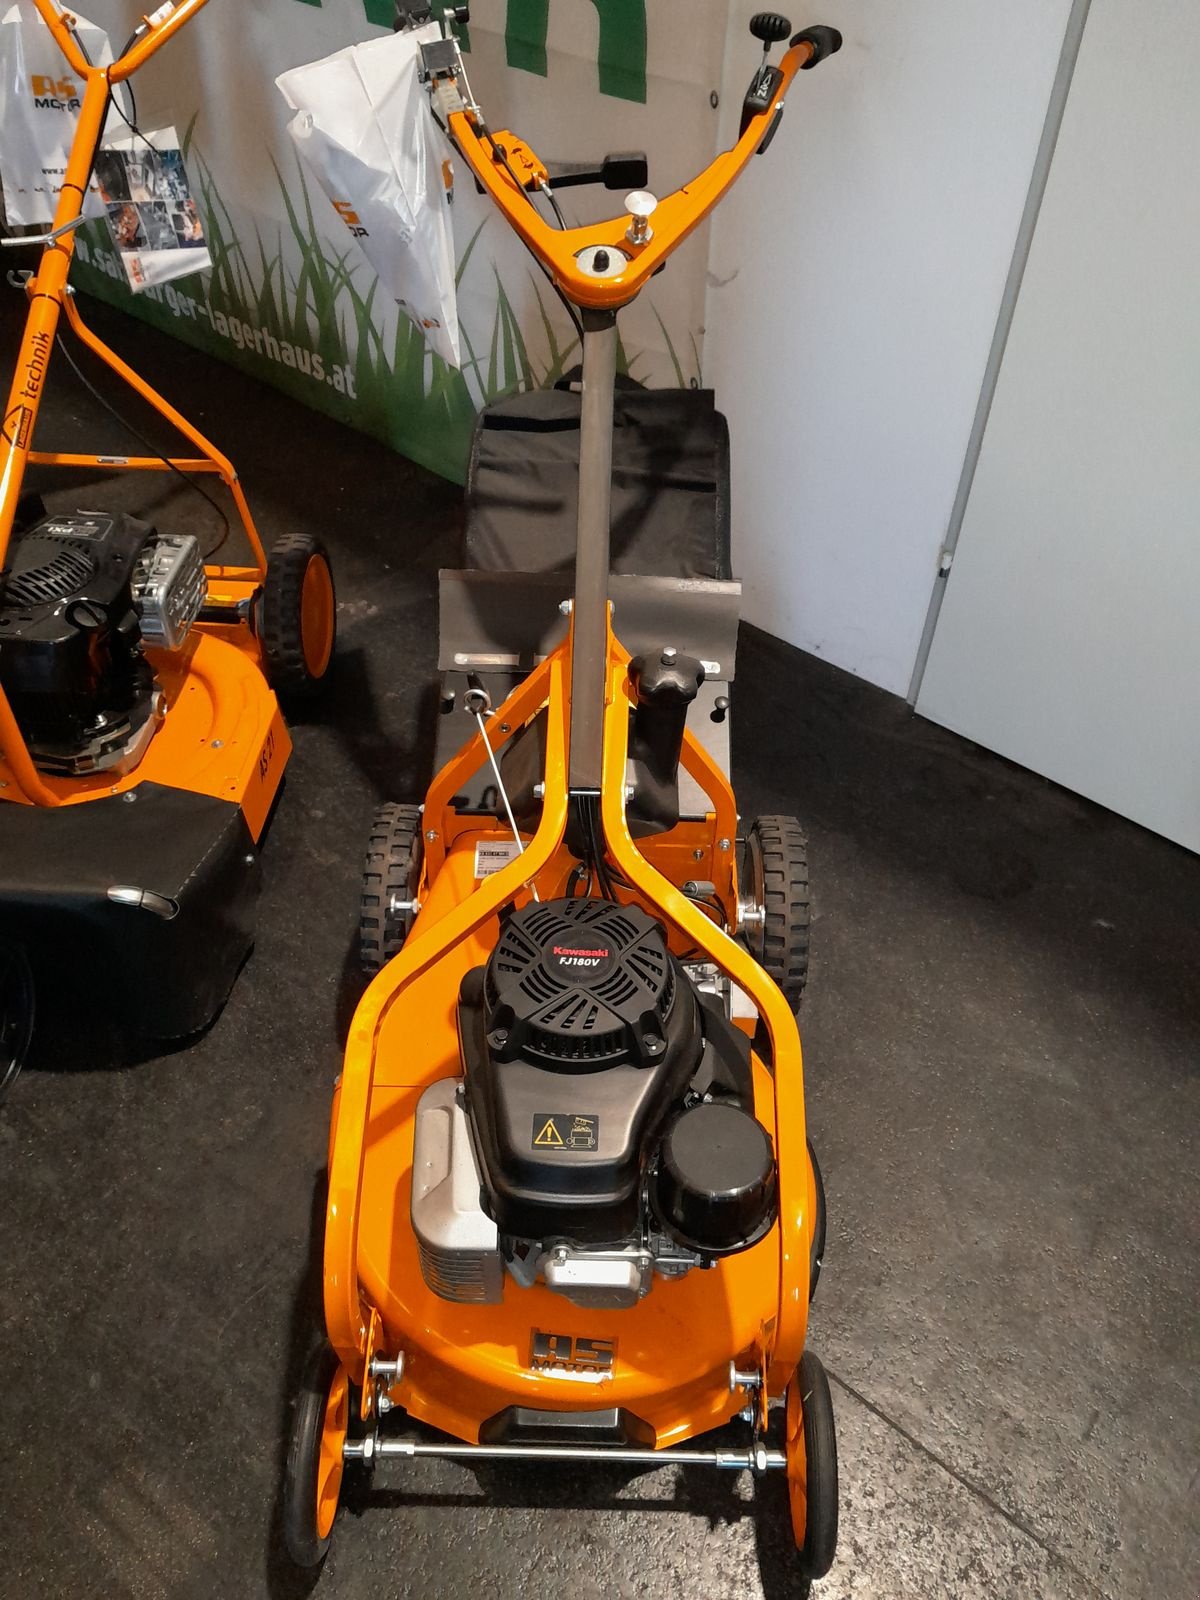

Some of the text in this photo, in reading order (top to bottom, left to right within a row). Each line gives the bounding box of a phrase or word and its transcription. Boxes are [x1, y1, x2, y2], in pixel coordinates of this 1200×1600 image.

[20, 331, 50, 399] technik
[553, 946, 608, 957] Kawasaki
[559, 957, 600, 966] FJ180V
[533, 1333, 613, 1366] AS
